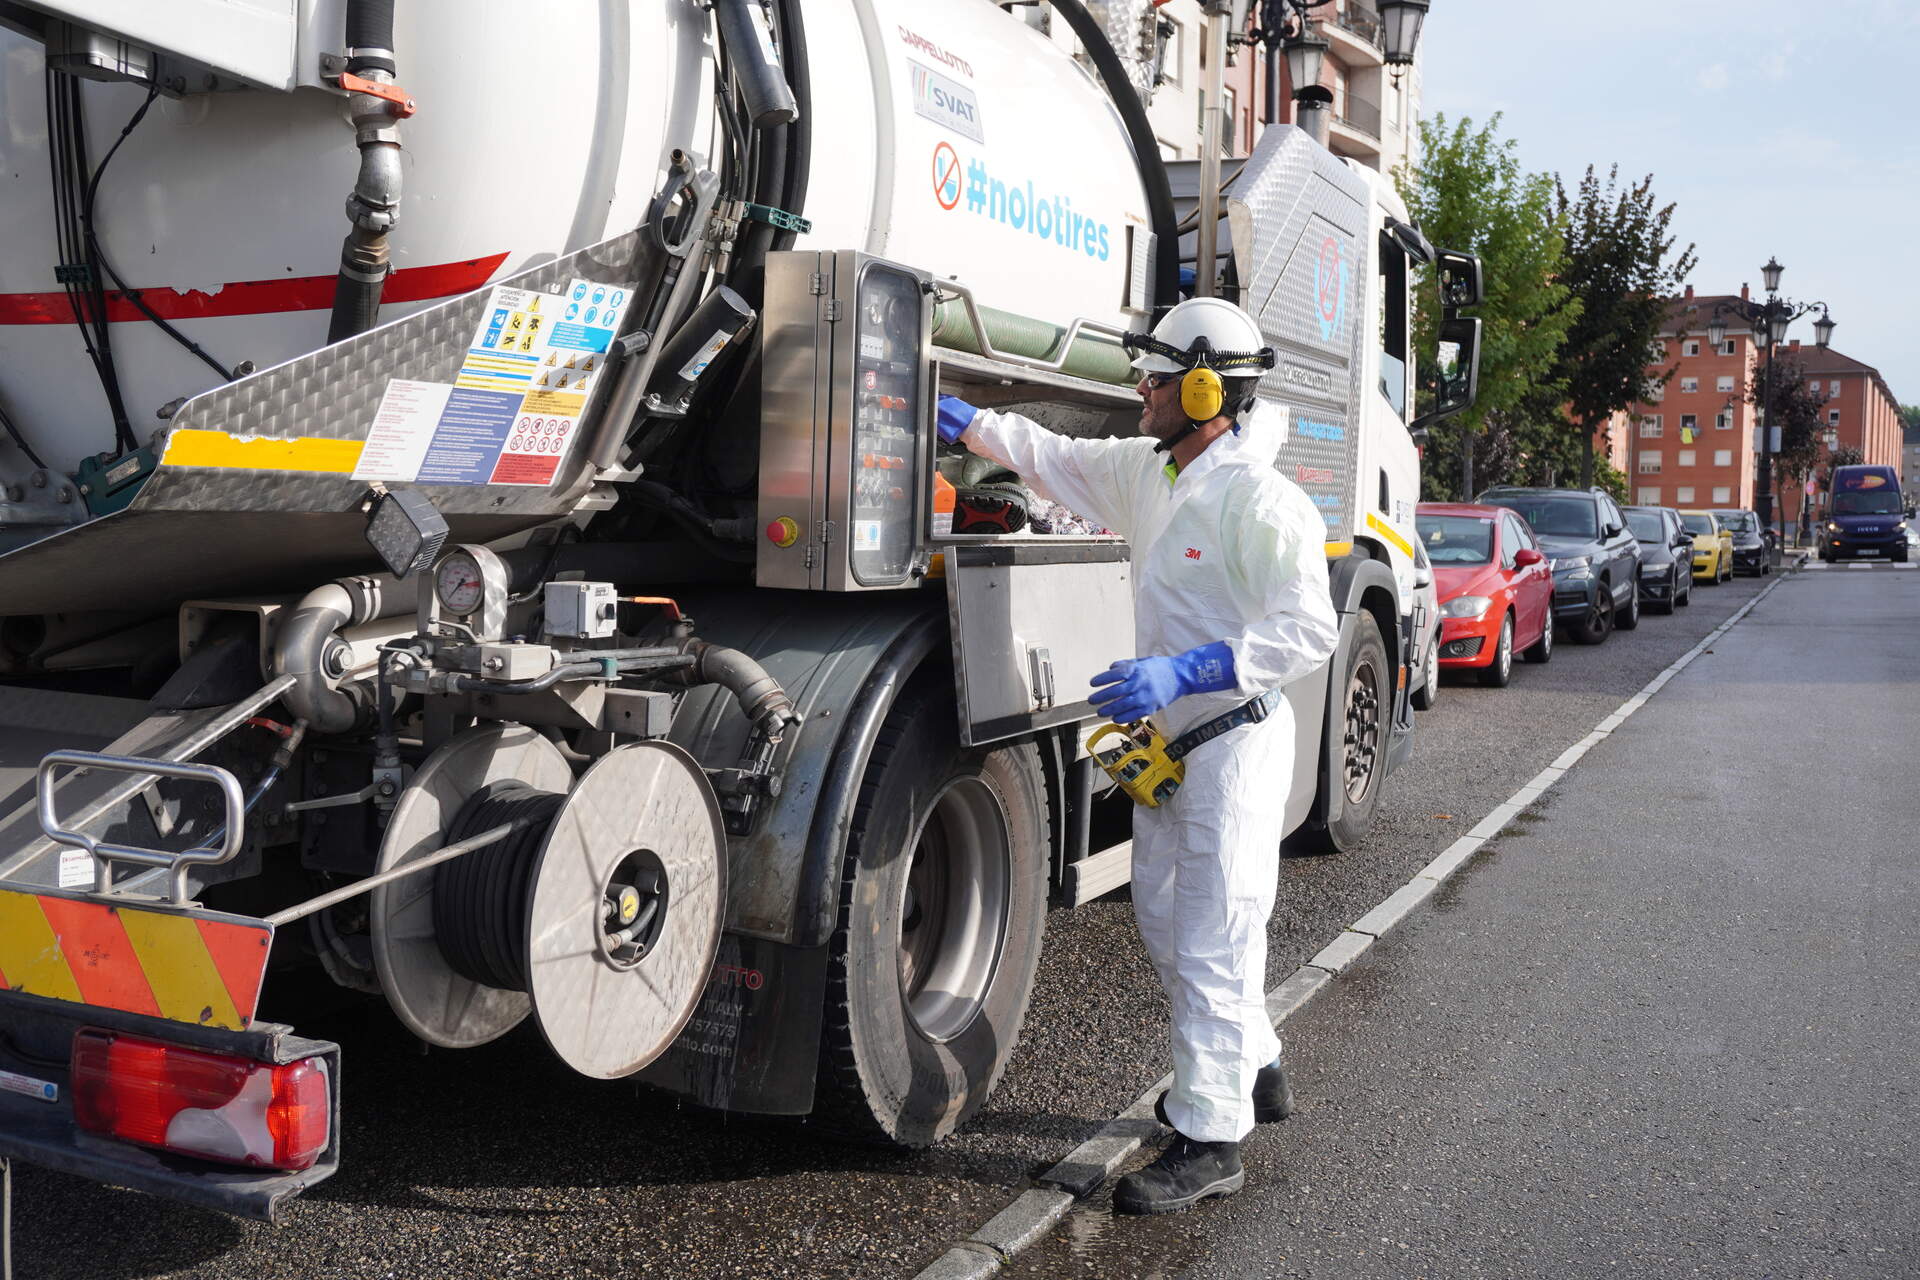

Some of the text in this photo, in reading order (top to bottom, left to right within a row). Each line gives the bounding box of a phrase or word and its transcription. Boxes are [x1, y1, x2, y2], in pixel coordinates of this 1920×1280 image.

[898, 24, 974, 79] CAPPELLOTTO
[933, 87, 974, 122] SVAT
[966, 157, 1109, 262] #nolotires
[1184, 547, 1202, 560] 3M
[1195, 715, 1236, 742] IMET
[704, 999, 743, 1018] ITALY
